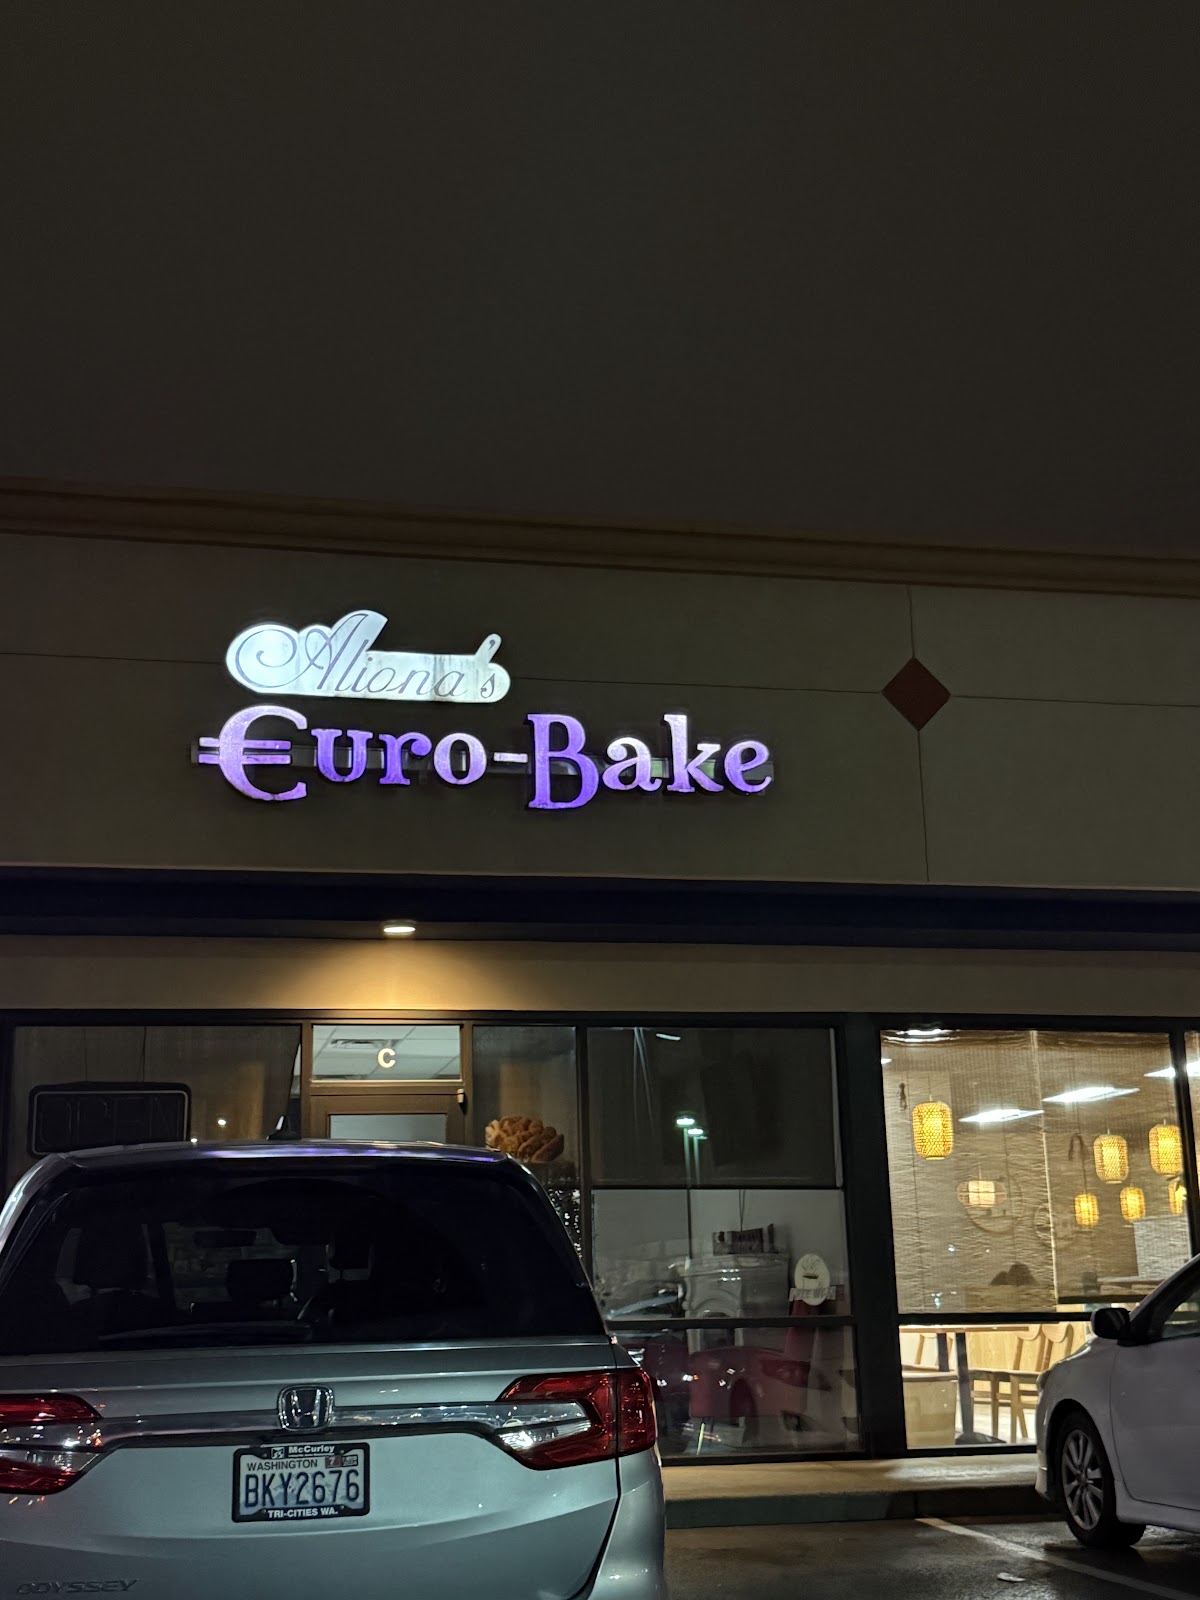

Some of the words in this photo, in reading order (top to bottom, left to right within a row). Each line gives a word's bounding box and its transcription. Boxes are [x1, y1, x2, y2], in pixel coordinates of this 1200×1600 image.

[235, 612, 496, 699] Aliona's
[378, 1048, 396, 1068] C
[288, 1445, 335, 1454] McCurley
[247, 1459, 318, 1471] WASHINGTON
[244, 1469, 360, 1508] BKY2676
[268, 1508, 318, 1518] TRI-CITIES
[320, 1507, 339, 1516] WA.
[17, 1579, 139, 1594] ODYSSEY
